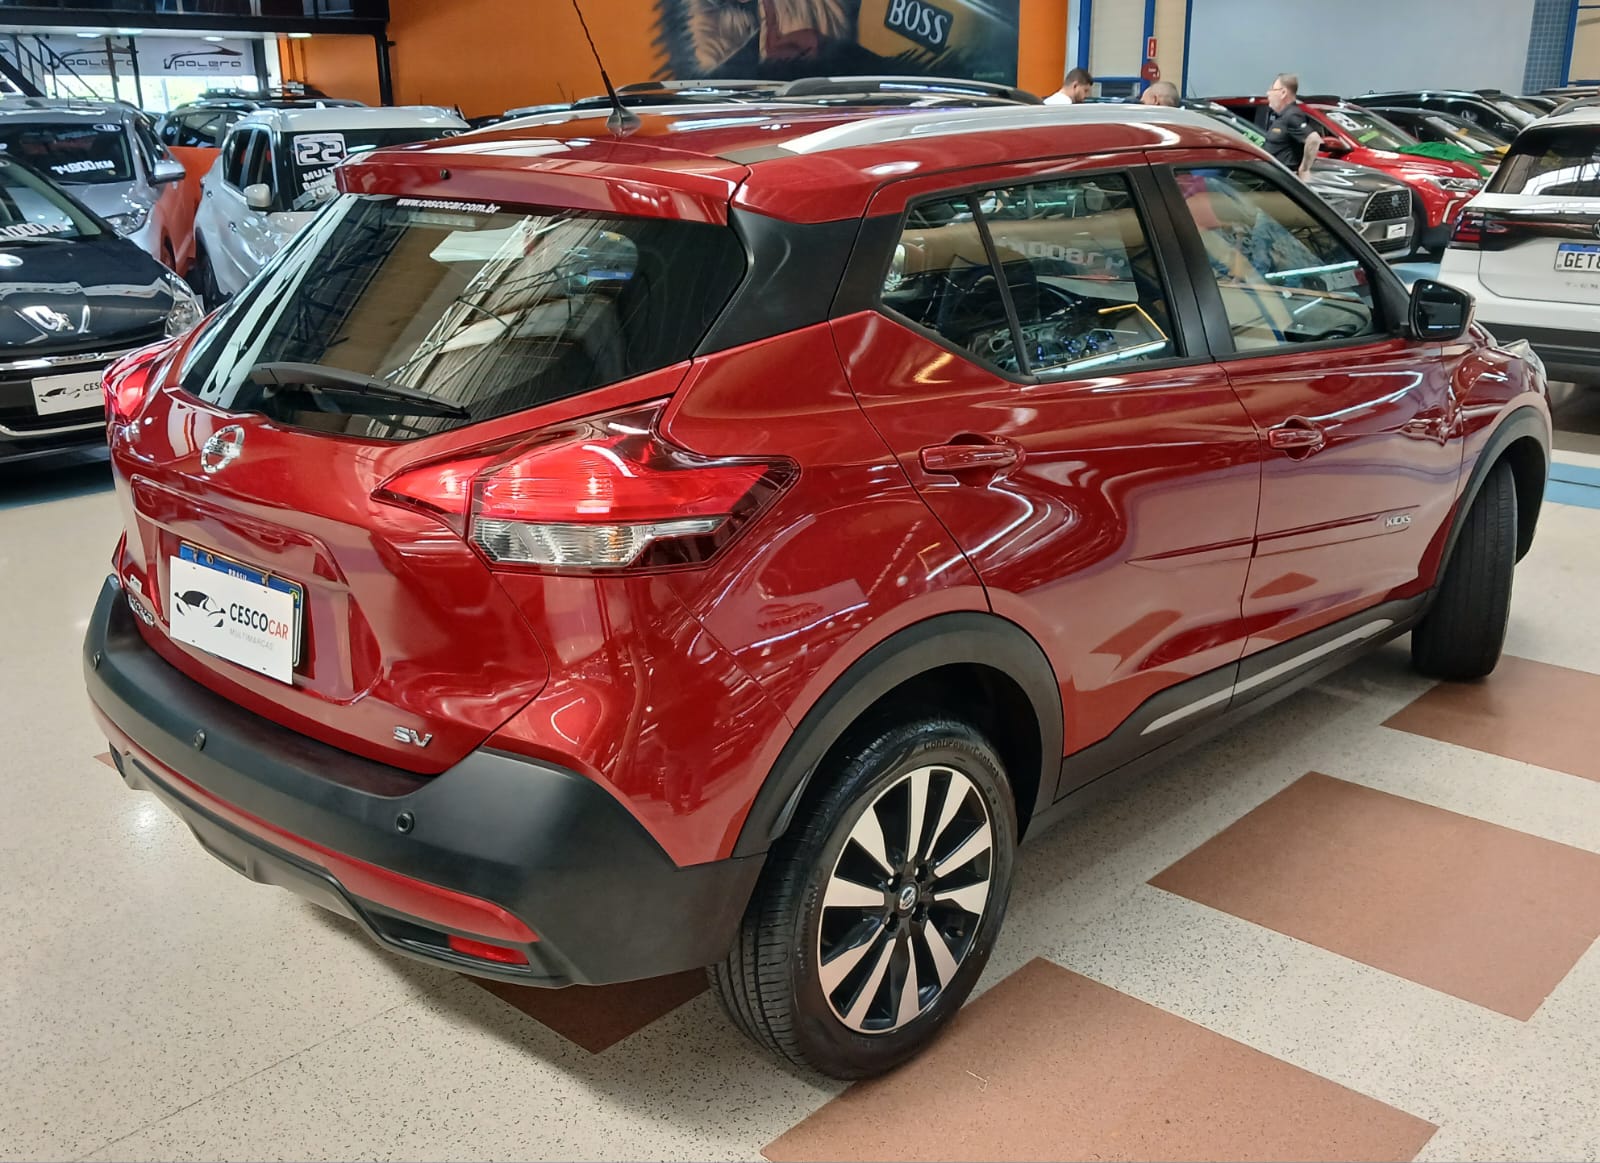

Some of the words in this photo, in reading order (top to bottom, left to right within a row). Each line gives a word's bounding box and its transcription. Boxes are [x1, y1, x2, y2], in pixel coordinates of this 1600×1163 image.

[889, 0, 948, 44] BOSS
[299, 141, 343, 163] 22
[397, 199, 501, 213] www.cescocar.com.br
[230, 602, 289, 640] CESCOCAR
[393, 725, 433, 747] SV
